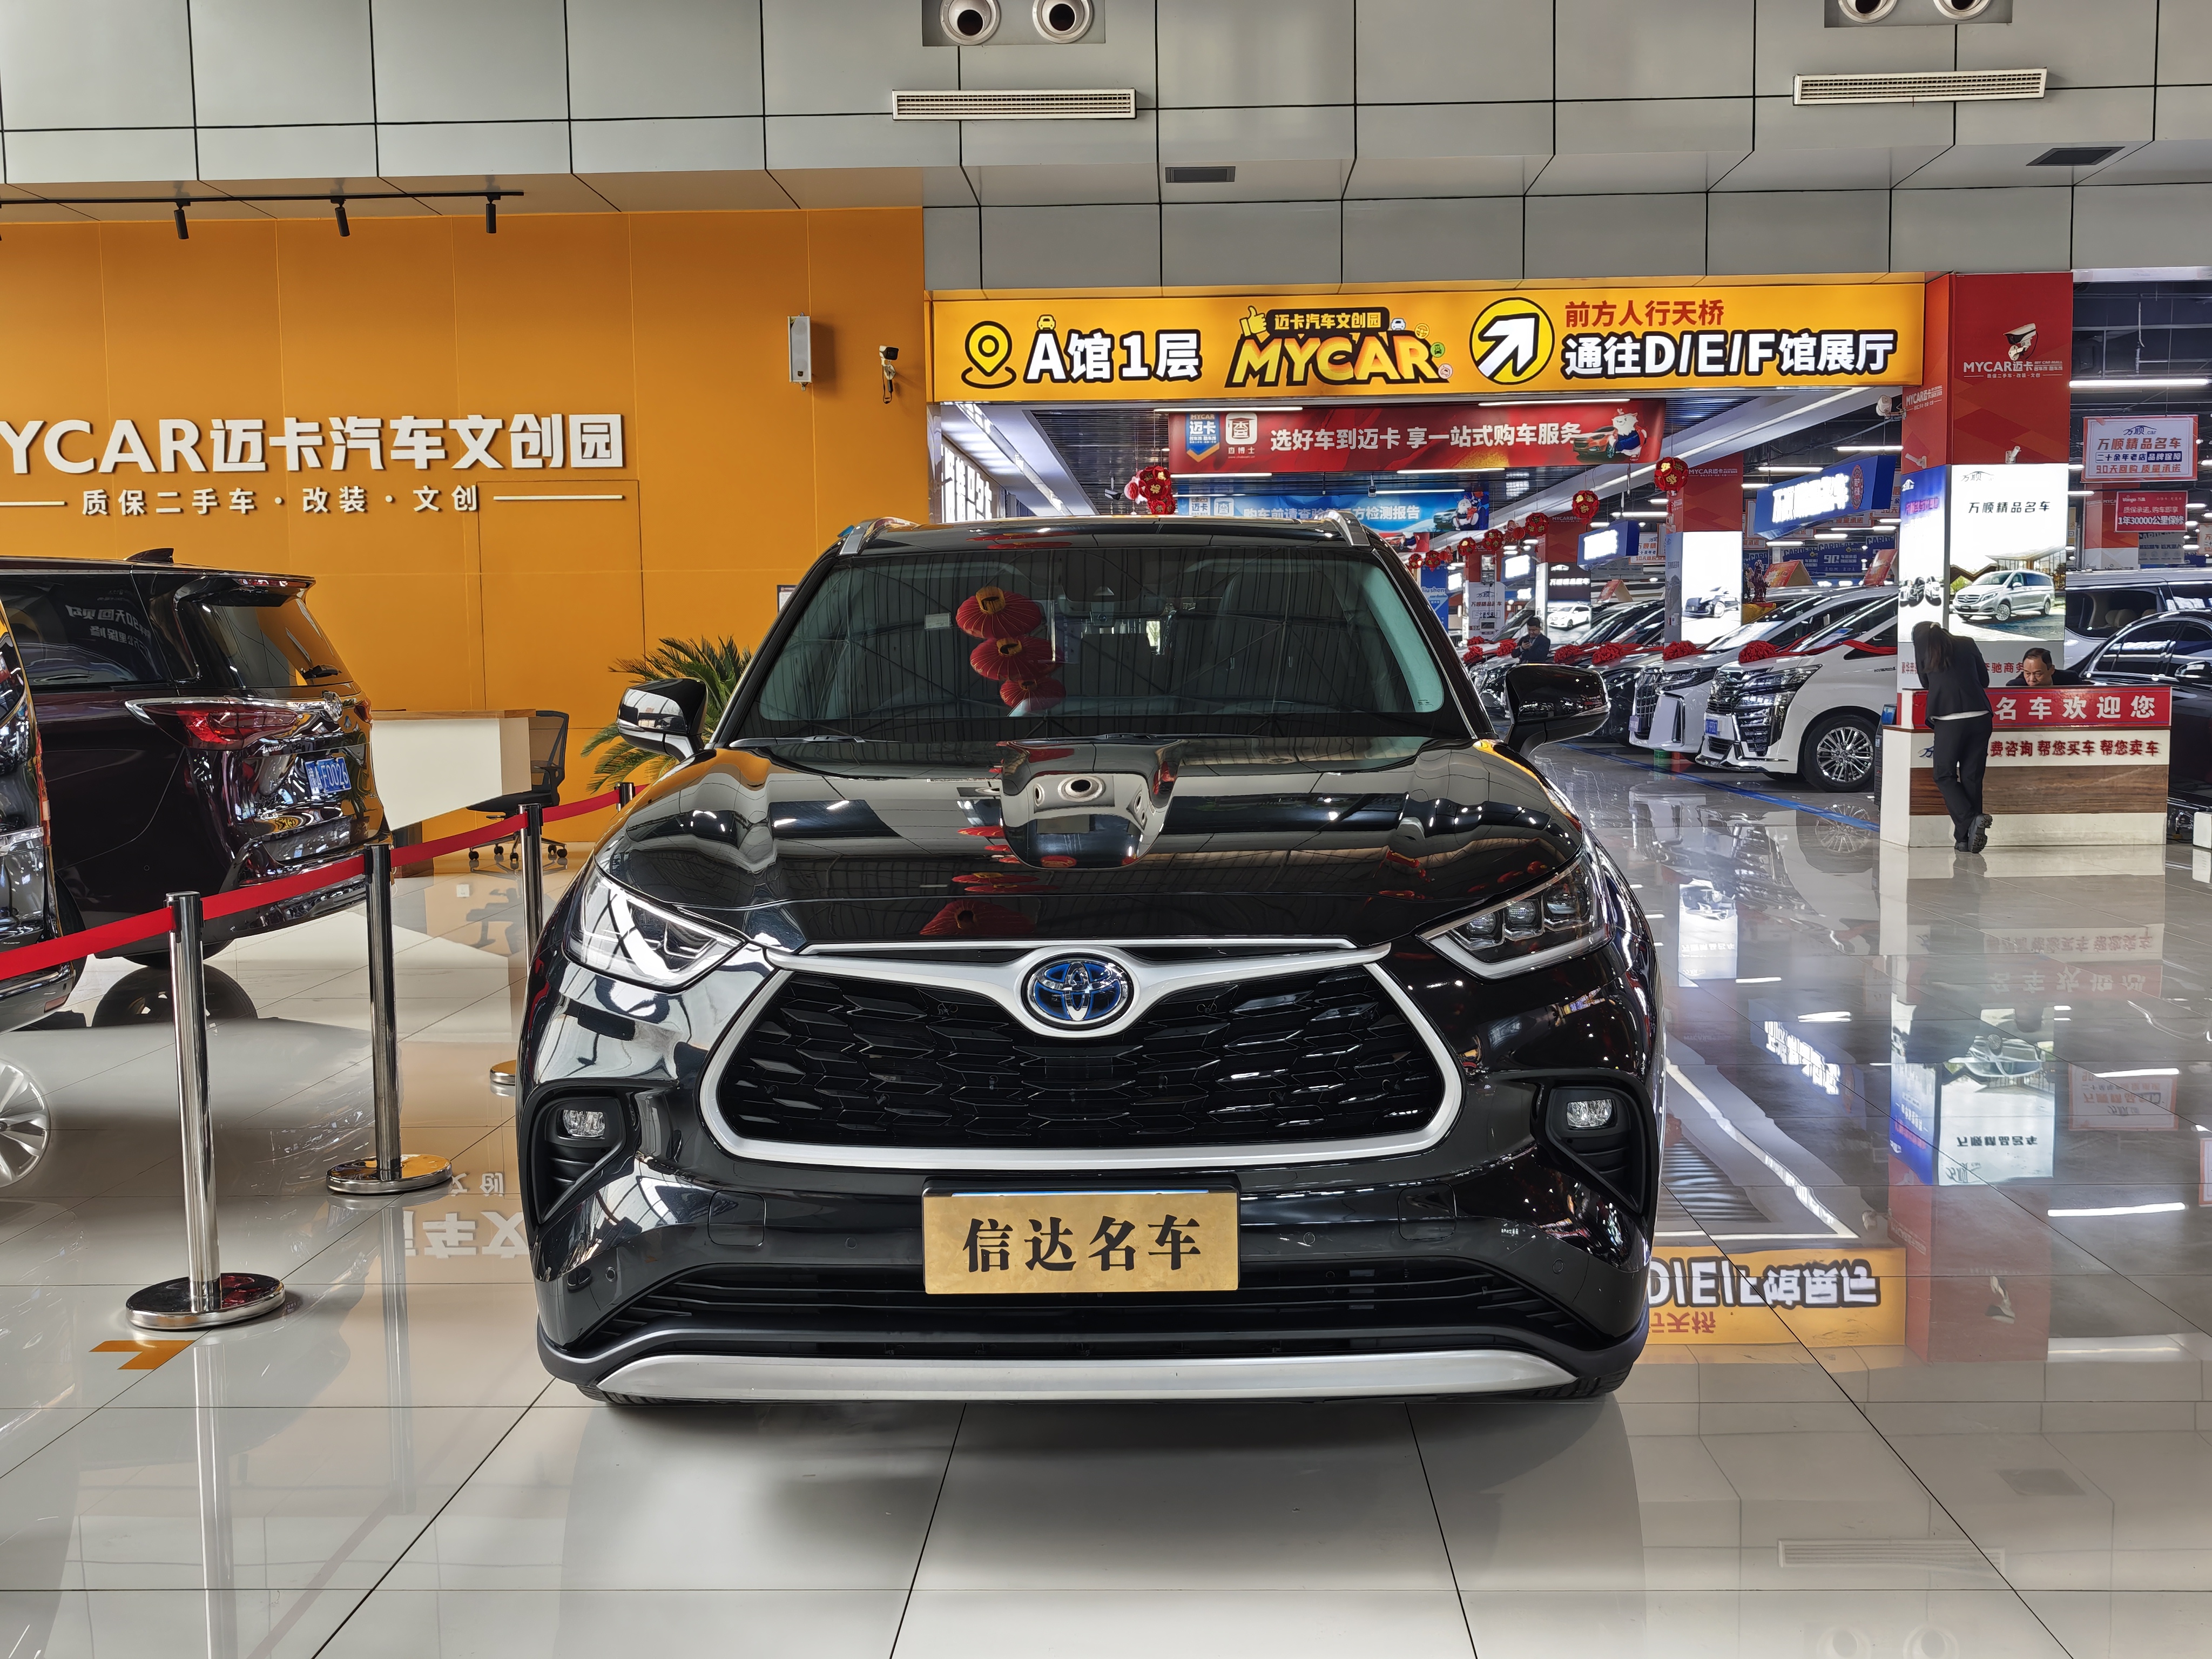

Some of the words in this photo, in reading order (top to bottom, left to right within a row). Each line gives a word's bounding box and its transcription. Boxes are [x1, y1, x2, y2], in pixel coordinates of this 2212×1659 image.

[1274, 312, 1382, 331] 迈卡汽车文创园
[1565, 300, 1725, 327] 前方人行天桥
[1026, 331, 1200, 381] A馆1层
[1232, 334, 1440, 383] MYCAR
[1565, 333, 1894, 376] 通往D/E/F馆展厅
[1189, 421, 1216, 435] 迈卡
[1270, 426, 1401, 451] 选好车到迈卡
[1407, 422, 1580, 449] 享一站式购车服务
[2097, 437, 2182, 450] 万顺精品名车
[1968, 501, 2051, 513] 万顺精品名车
[1994, 695, 2155, 721] 名车欢迎您
[1988, 740, 2033, 757] 费咨询
[2038, 740, 2095, 756] 帮您买车
[2100, 739, 2159, 757] 帮您卖车
[963, 1214, 1201, 1273] 信达名车
